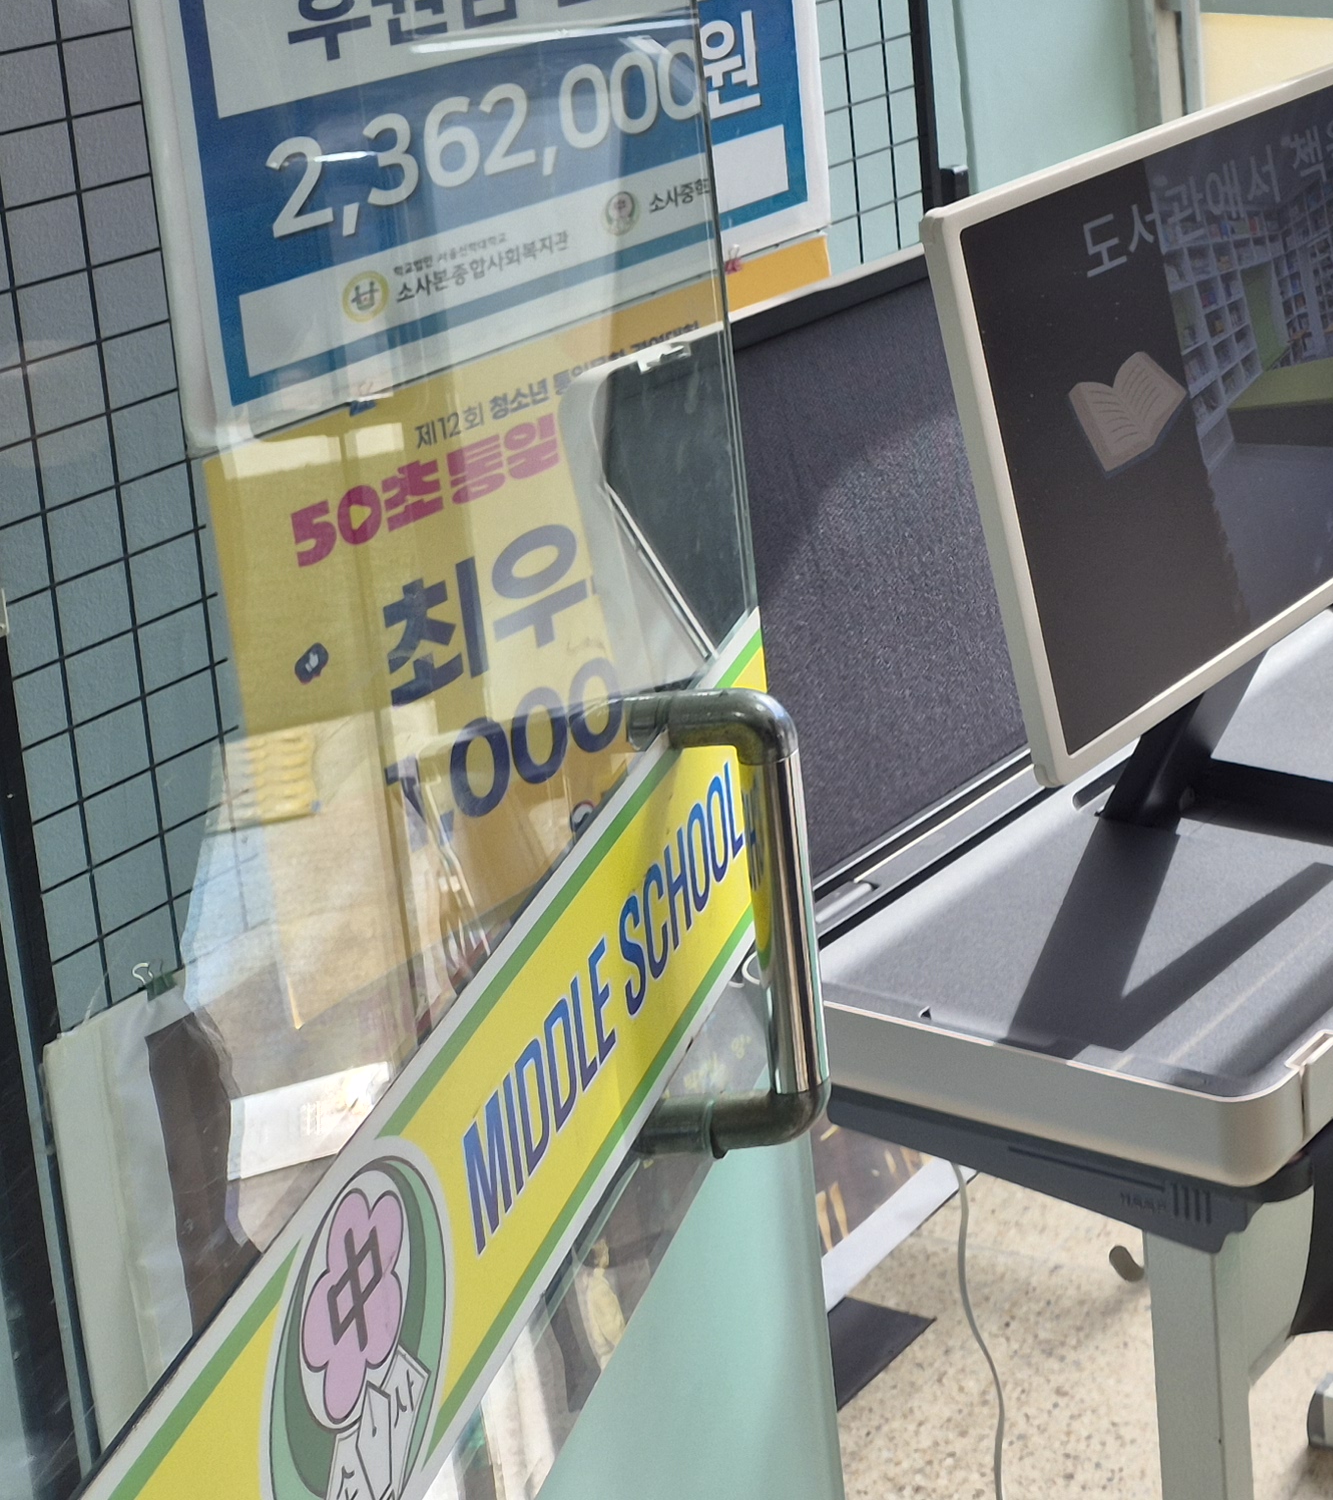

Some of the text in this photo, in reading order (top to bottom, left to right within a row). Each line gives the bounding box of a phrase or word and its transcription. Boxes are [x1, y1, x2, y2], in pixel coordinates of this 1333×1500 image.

[265, 9, 763, 239] 2,362,000원
[1082, 146, 1282, 279] 도서관에서
[414, 403, 485, 449] 제12회
[489, 378, 549, 421] 청소년
[462, 936, 617, 1257] MIDDLE
[619, 761, 744, 1016] SCHOOL
